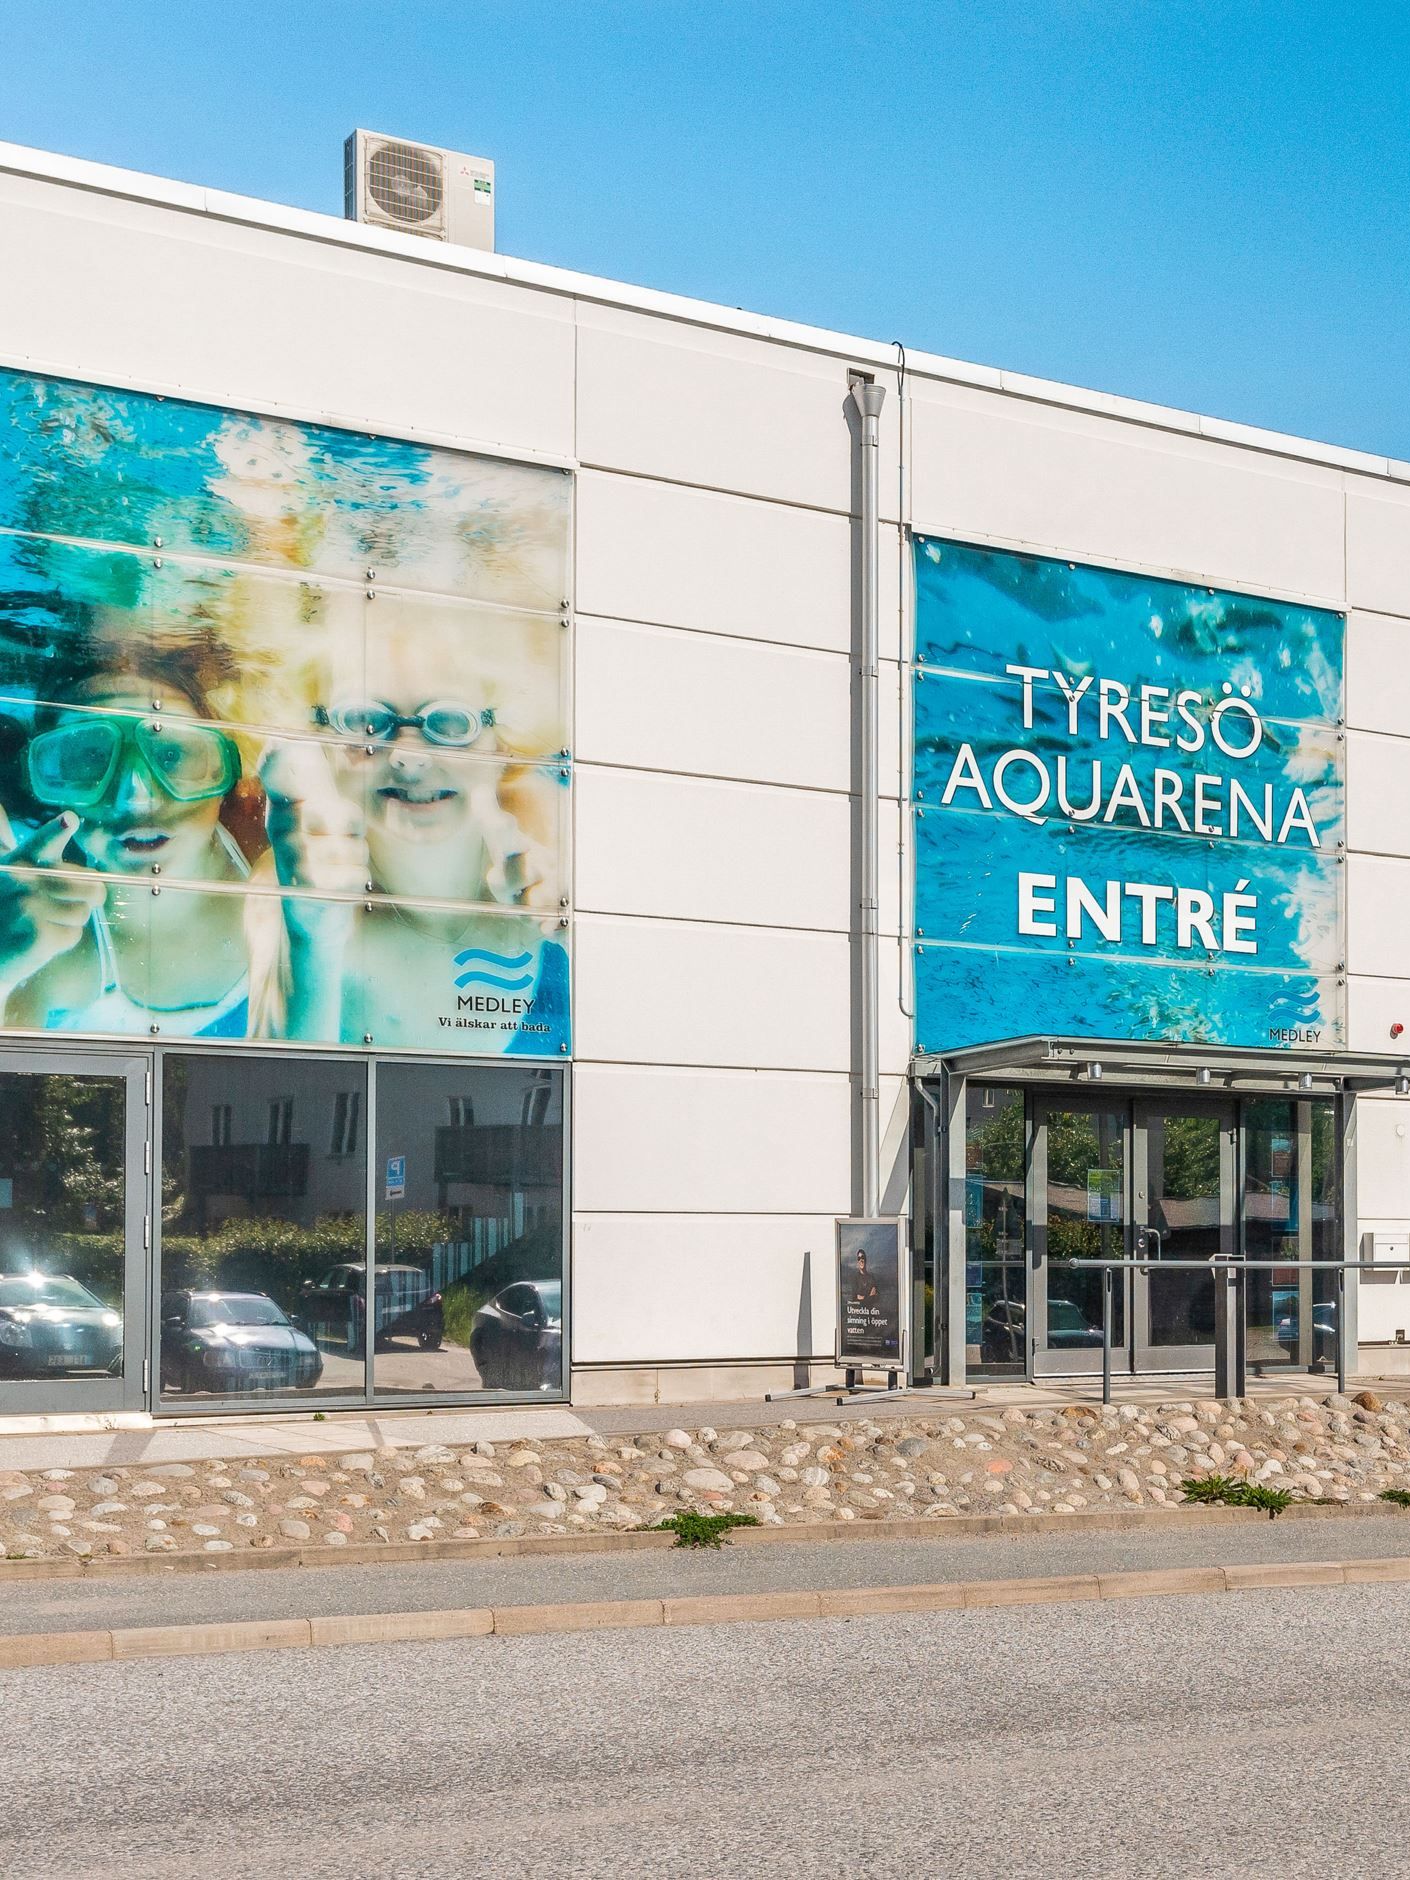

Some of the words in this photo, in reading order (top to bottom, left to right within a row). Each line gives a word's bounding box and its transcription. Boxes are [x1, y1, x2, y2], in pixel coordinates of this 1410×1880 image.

[1005, 664, 1263, 759] TYRESÖ
[941, 743, 1321, 849] AQUARENA
[1017, 871, 1259, 955] ENTRÉ
[438, 1017, 451, 1027] Vi
[455, 1017, 497, 1030] älskar
[500, 1021, 518, 1031] att
[521, 1022, 551, 1032] bada
[457, 995, 535, 1014] MEDLEY
[1269, 1028, 1321, 1043] MEDLEY
